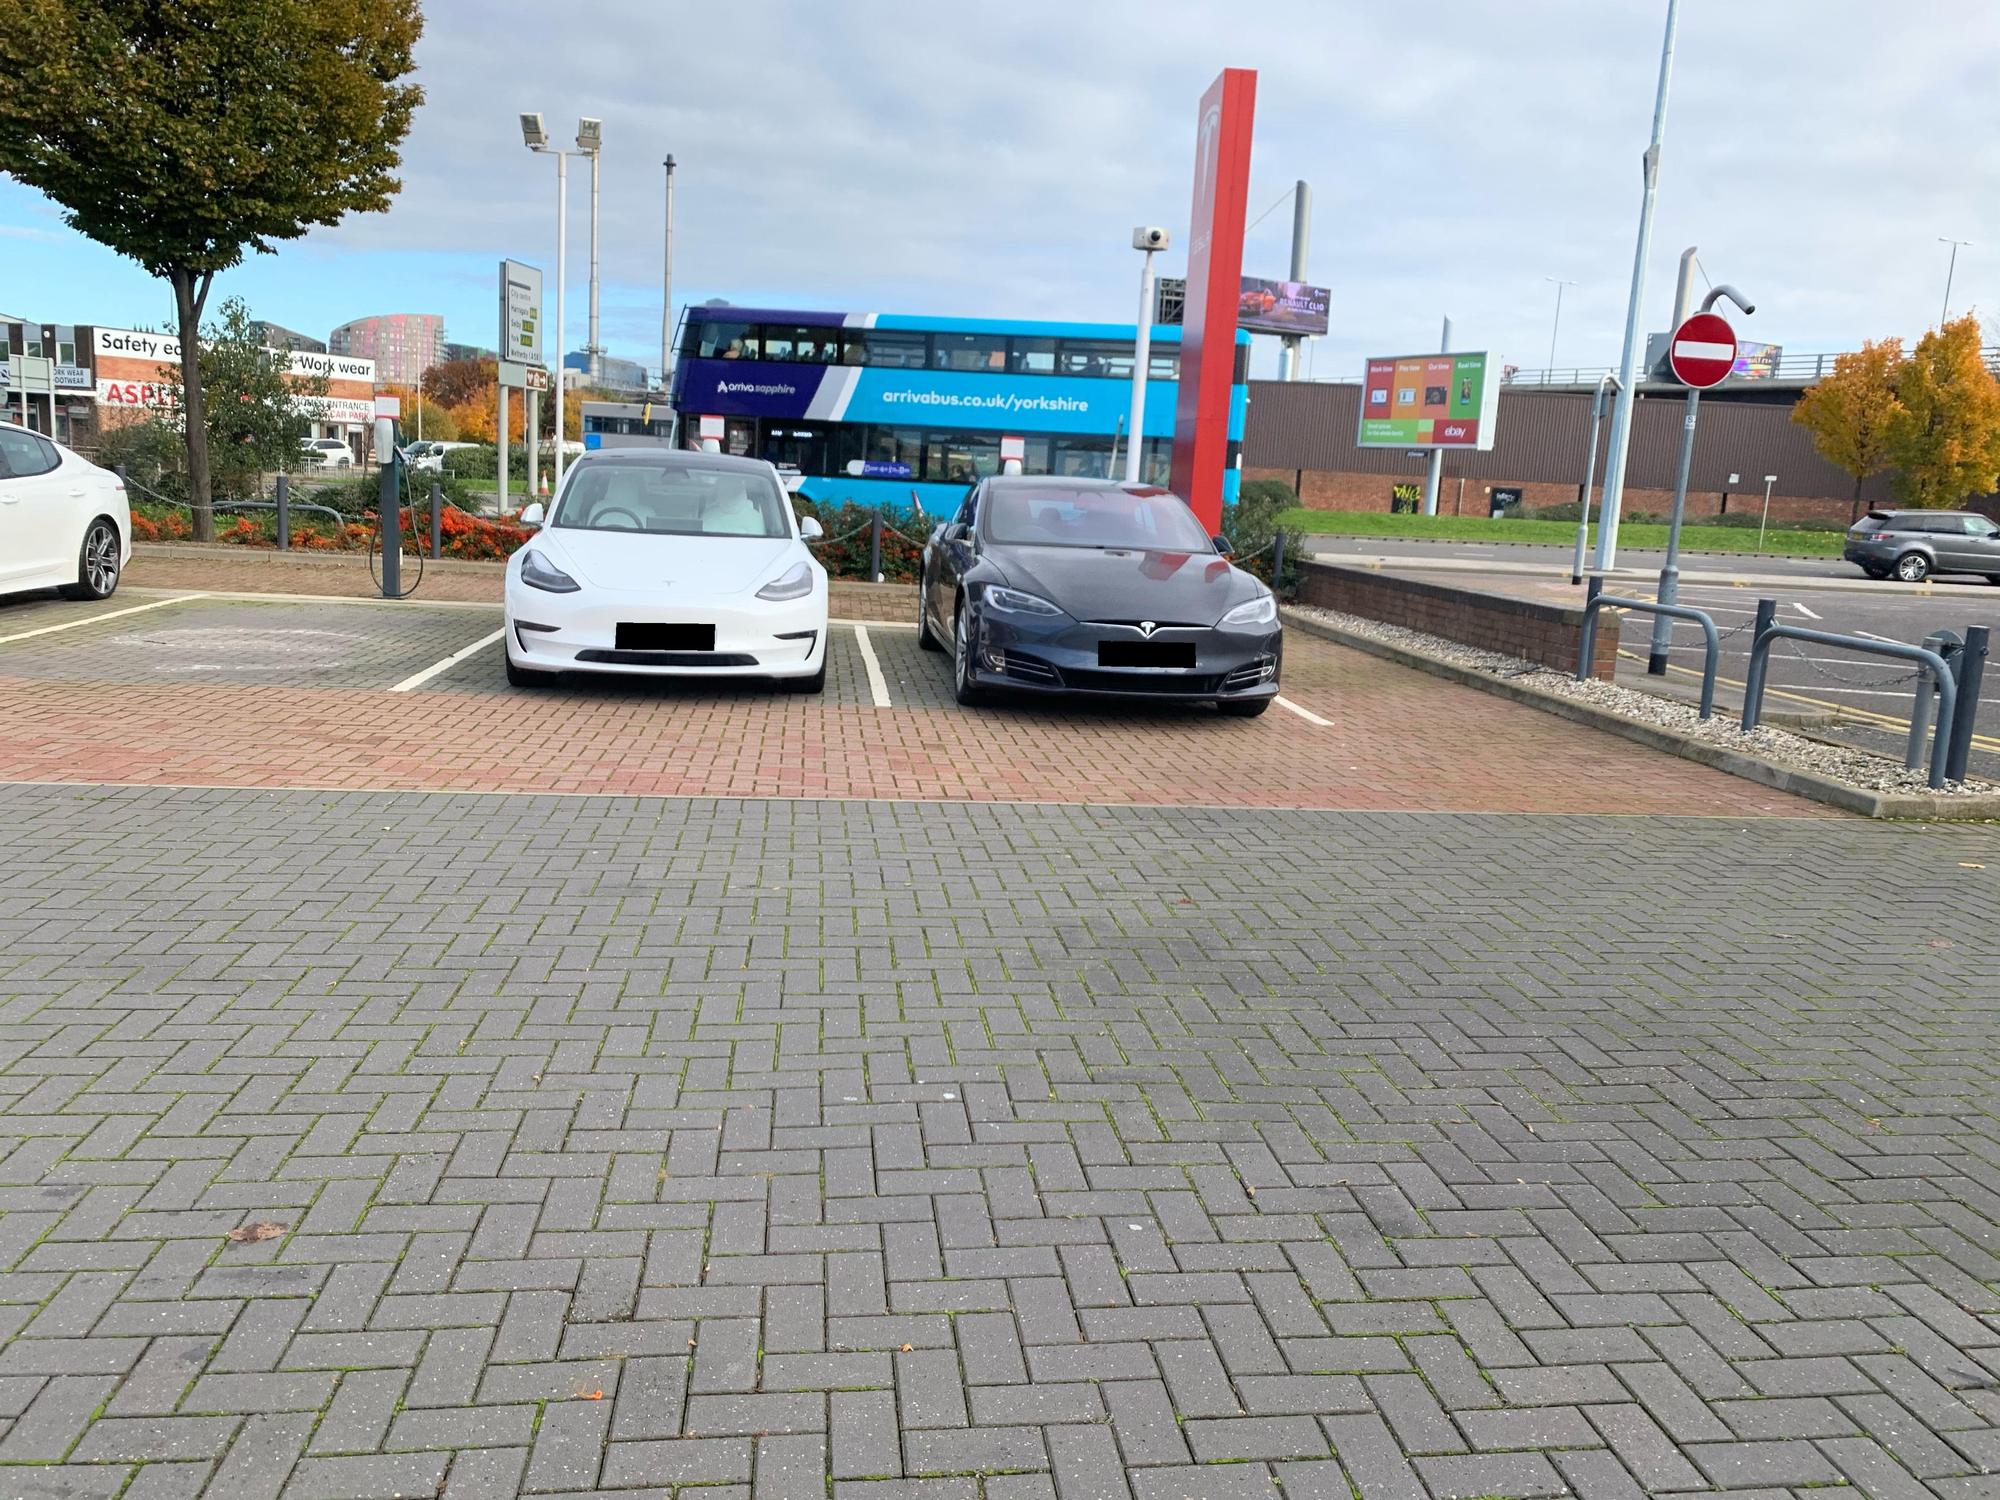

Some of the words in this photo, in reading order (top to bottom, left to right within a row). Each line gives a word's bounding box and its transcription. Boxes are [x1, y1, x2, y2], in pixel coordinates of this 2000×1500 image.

[1308, 302, 1324, 312] CLIO
[102, 333, 157, 357] Safety
[300, 355, 335, 374] Work
[338, 362, 371, 375] wear
[54, 376, 84, 384] OOTWEAR
[729, 382, 755, 392] arriva
[755, 384, 796, 395] sapphire
[882, 390, 1088, 412] arrivabus.co.uk/yorkshire
[329, 410, 347, 419] CAR
[348, 411, 369, 421] PARK
[1445, 425, 1466, 439] ebay
